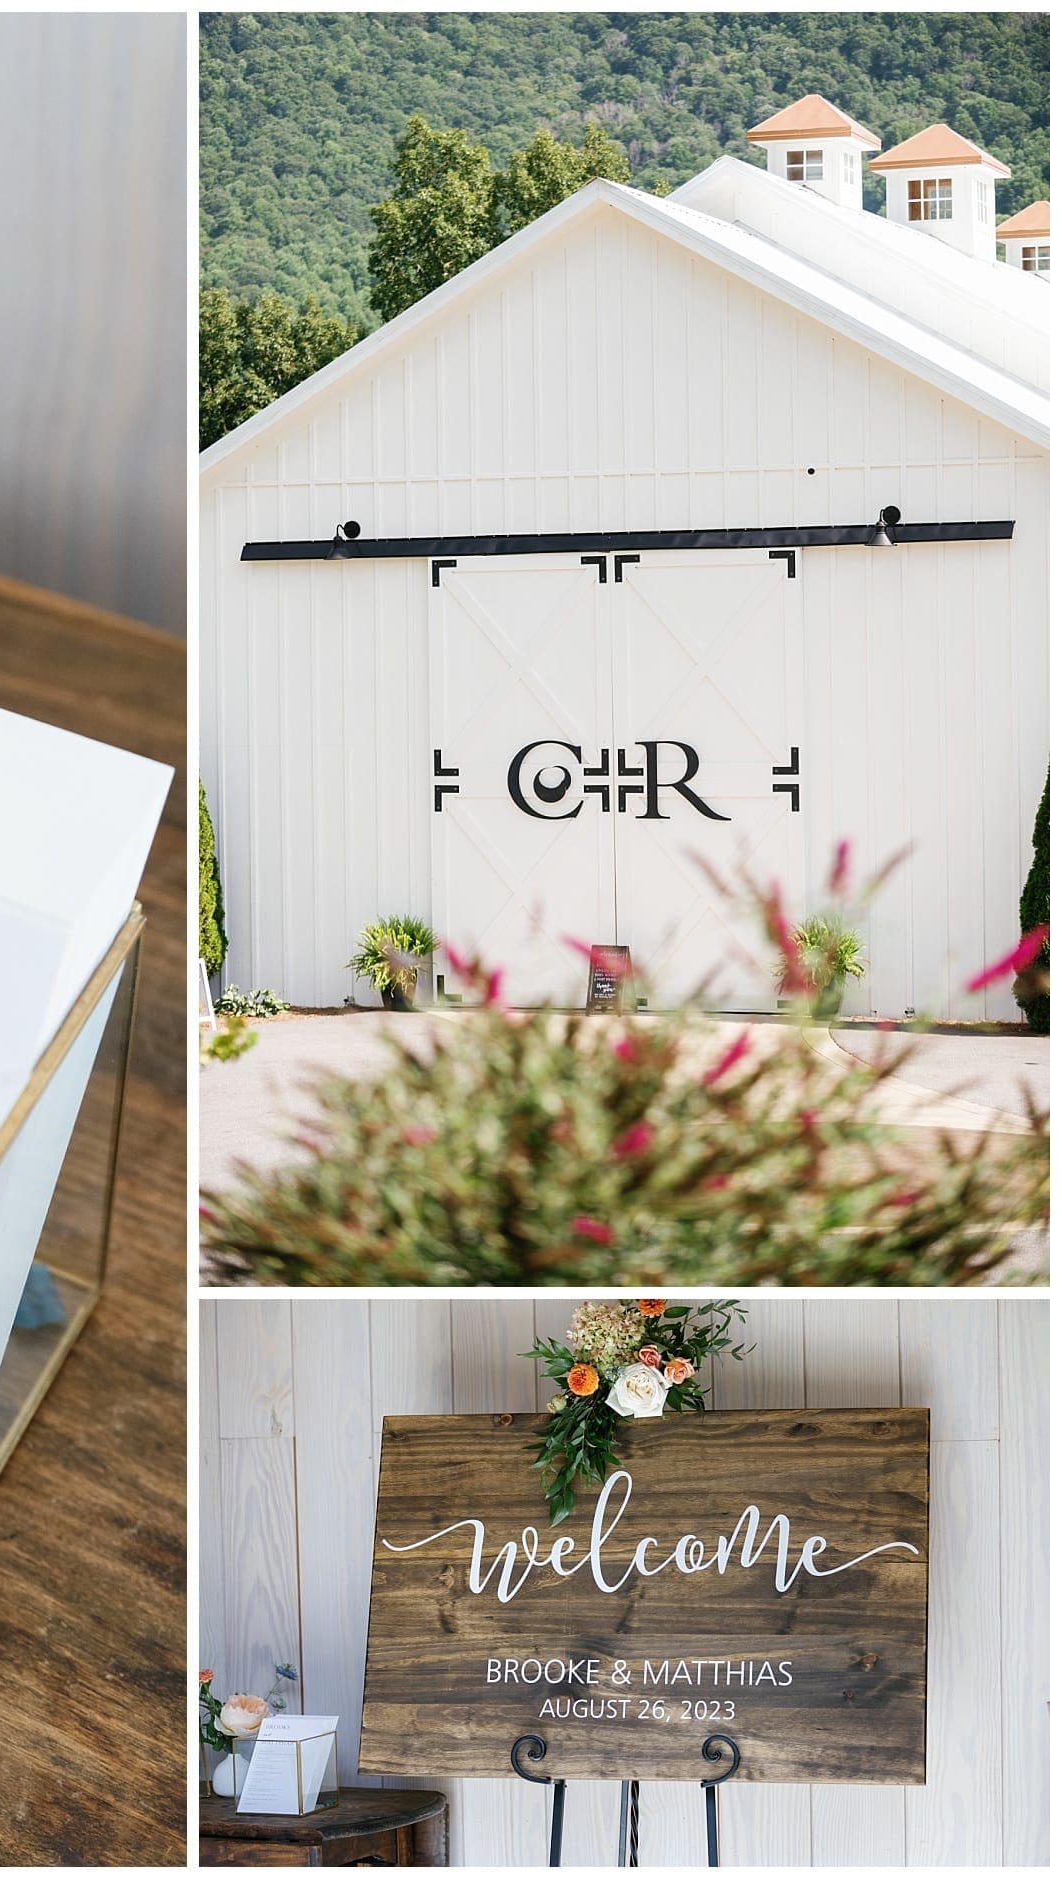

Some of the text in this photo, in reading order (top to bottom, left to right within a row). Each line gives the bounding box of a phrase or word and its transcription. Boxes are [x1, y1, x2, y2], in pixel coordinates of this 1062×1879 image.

[486, 1658, 794, 1687] BROOKE & MATTHIAS
[539, 1699, 736, 1723] AUGUST 26, 2023
